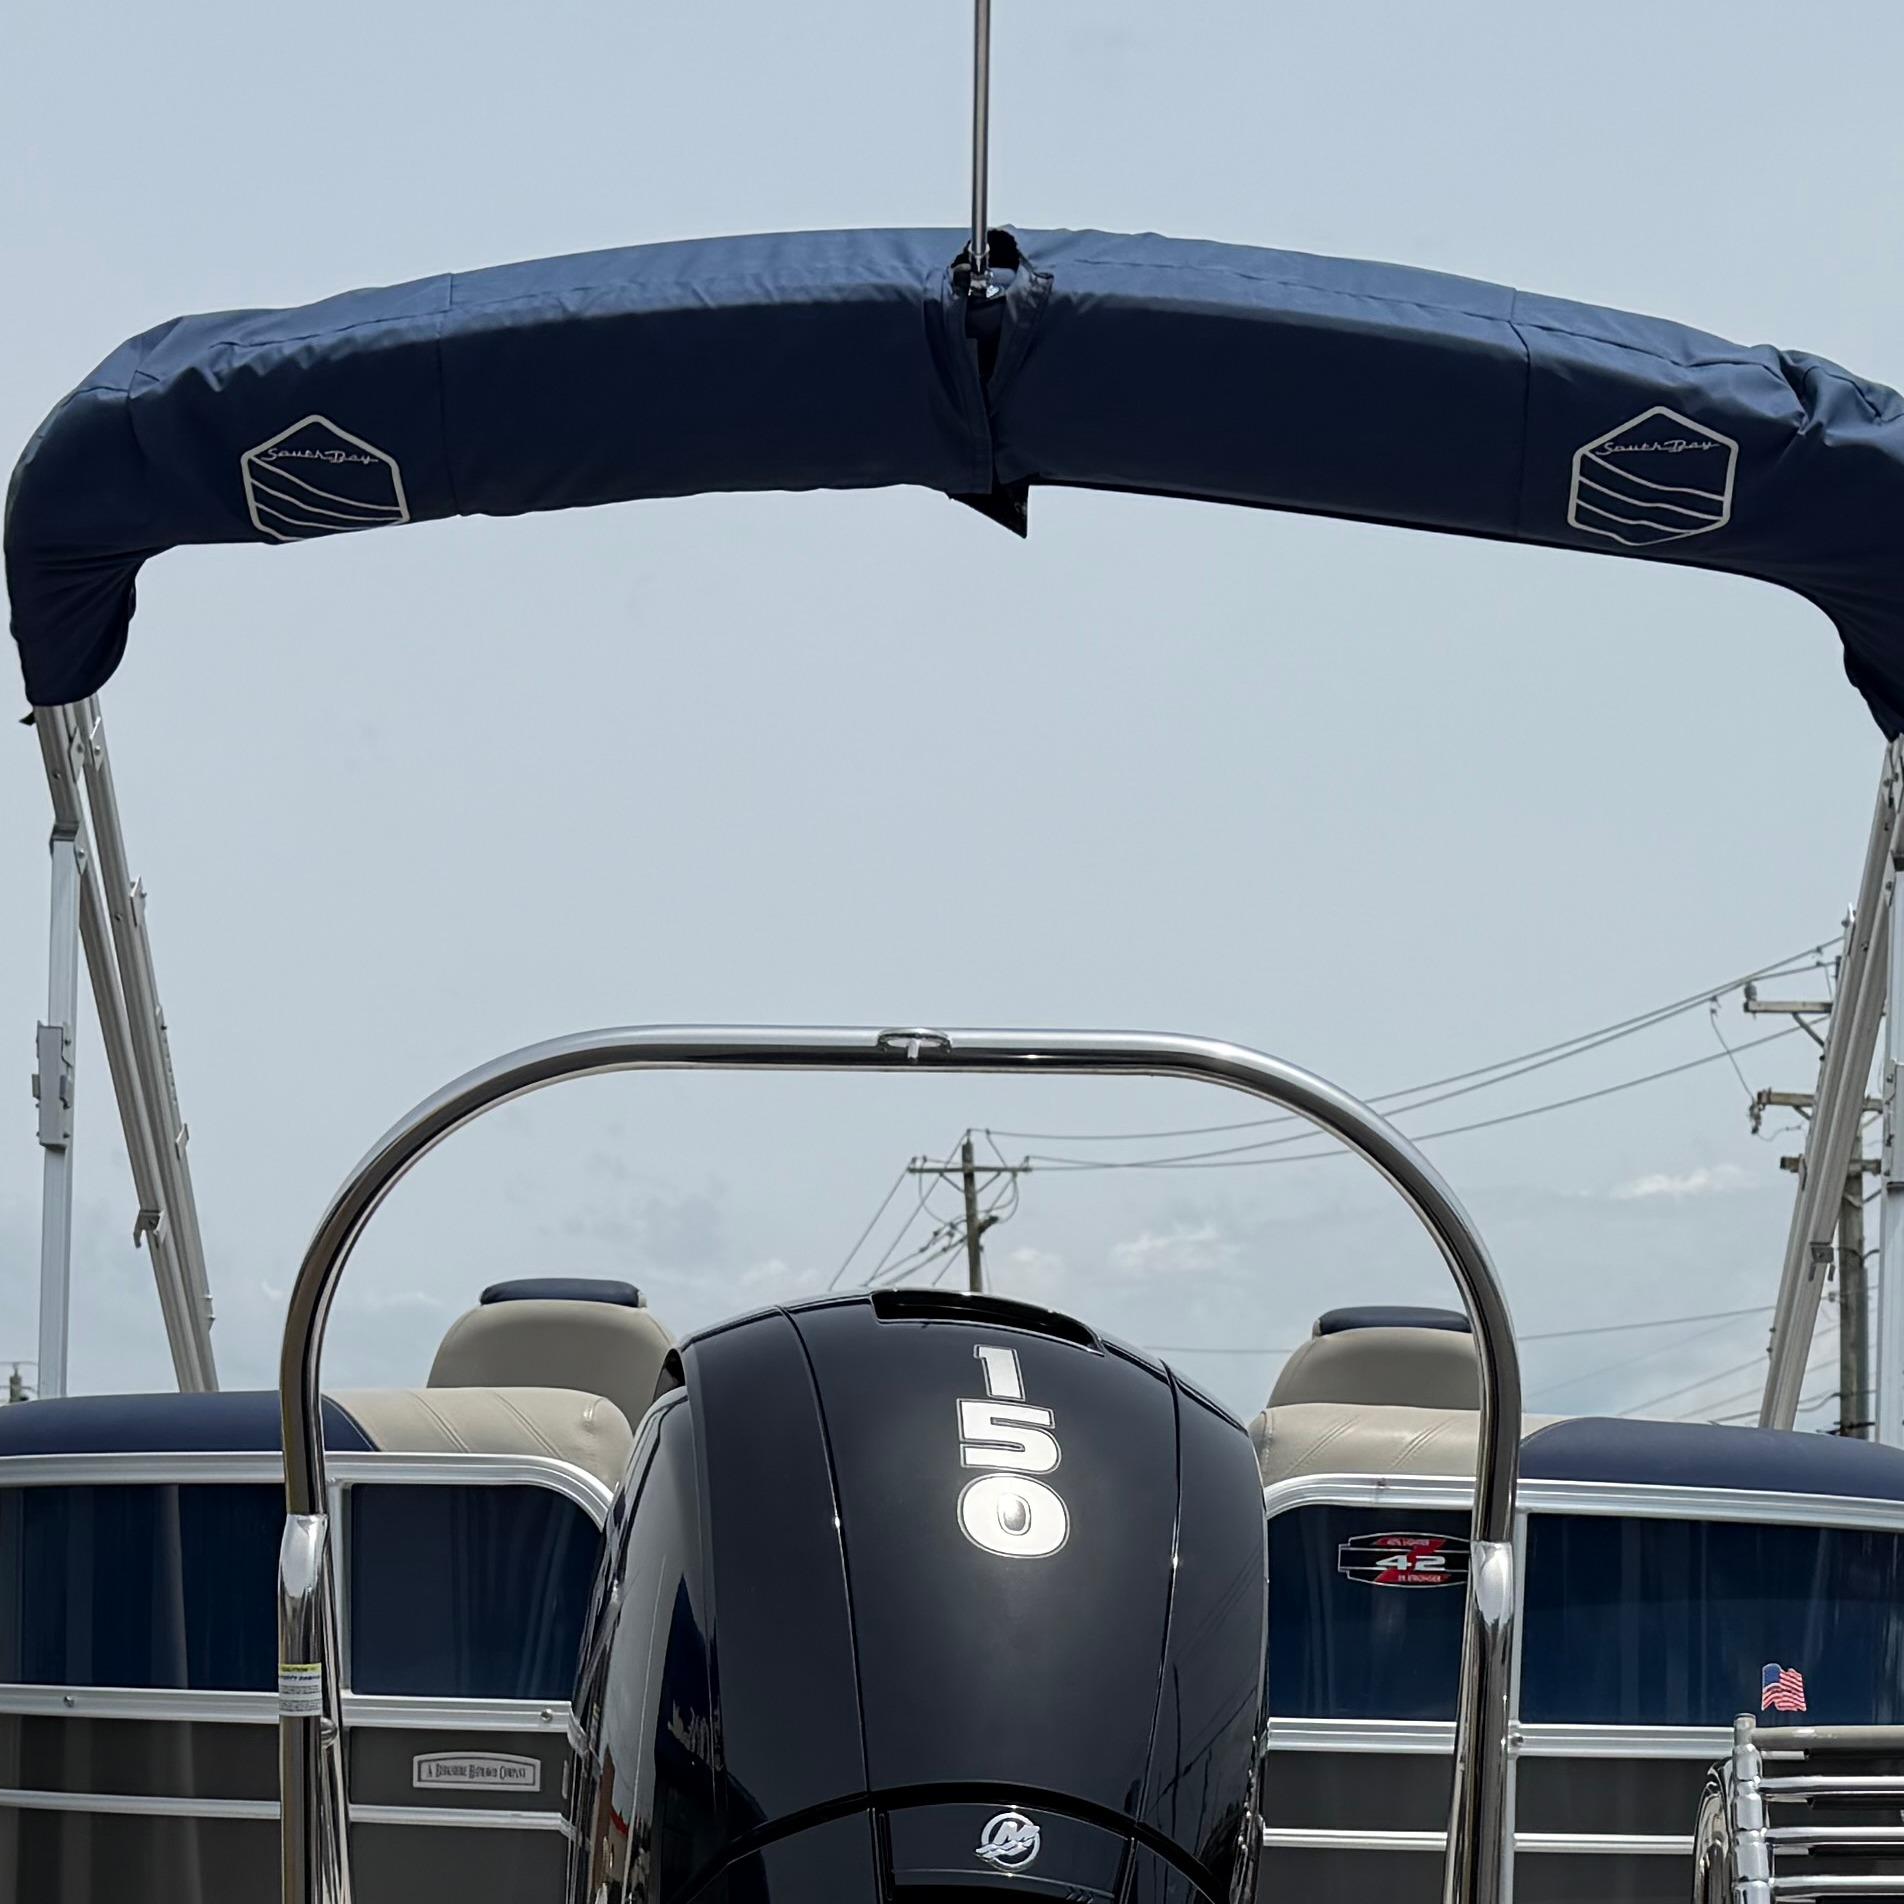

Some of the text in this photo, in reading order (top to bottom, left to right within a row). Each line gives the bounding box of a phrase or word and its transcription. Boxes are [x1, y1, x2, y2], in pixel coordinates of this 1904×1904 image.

[1596, 439, 1720, 455] South Bay
[261, 448, 379, 464] South Bay
[957, 1344, 1070, 1559] 150
